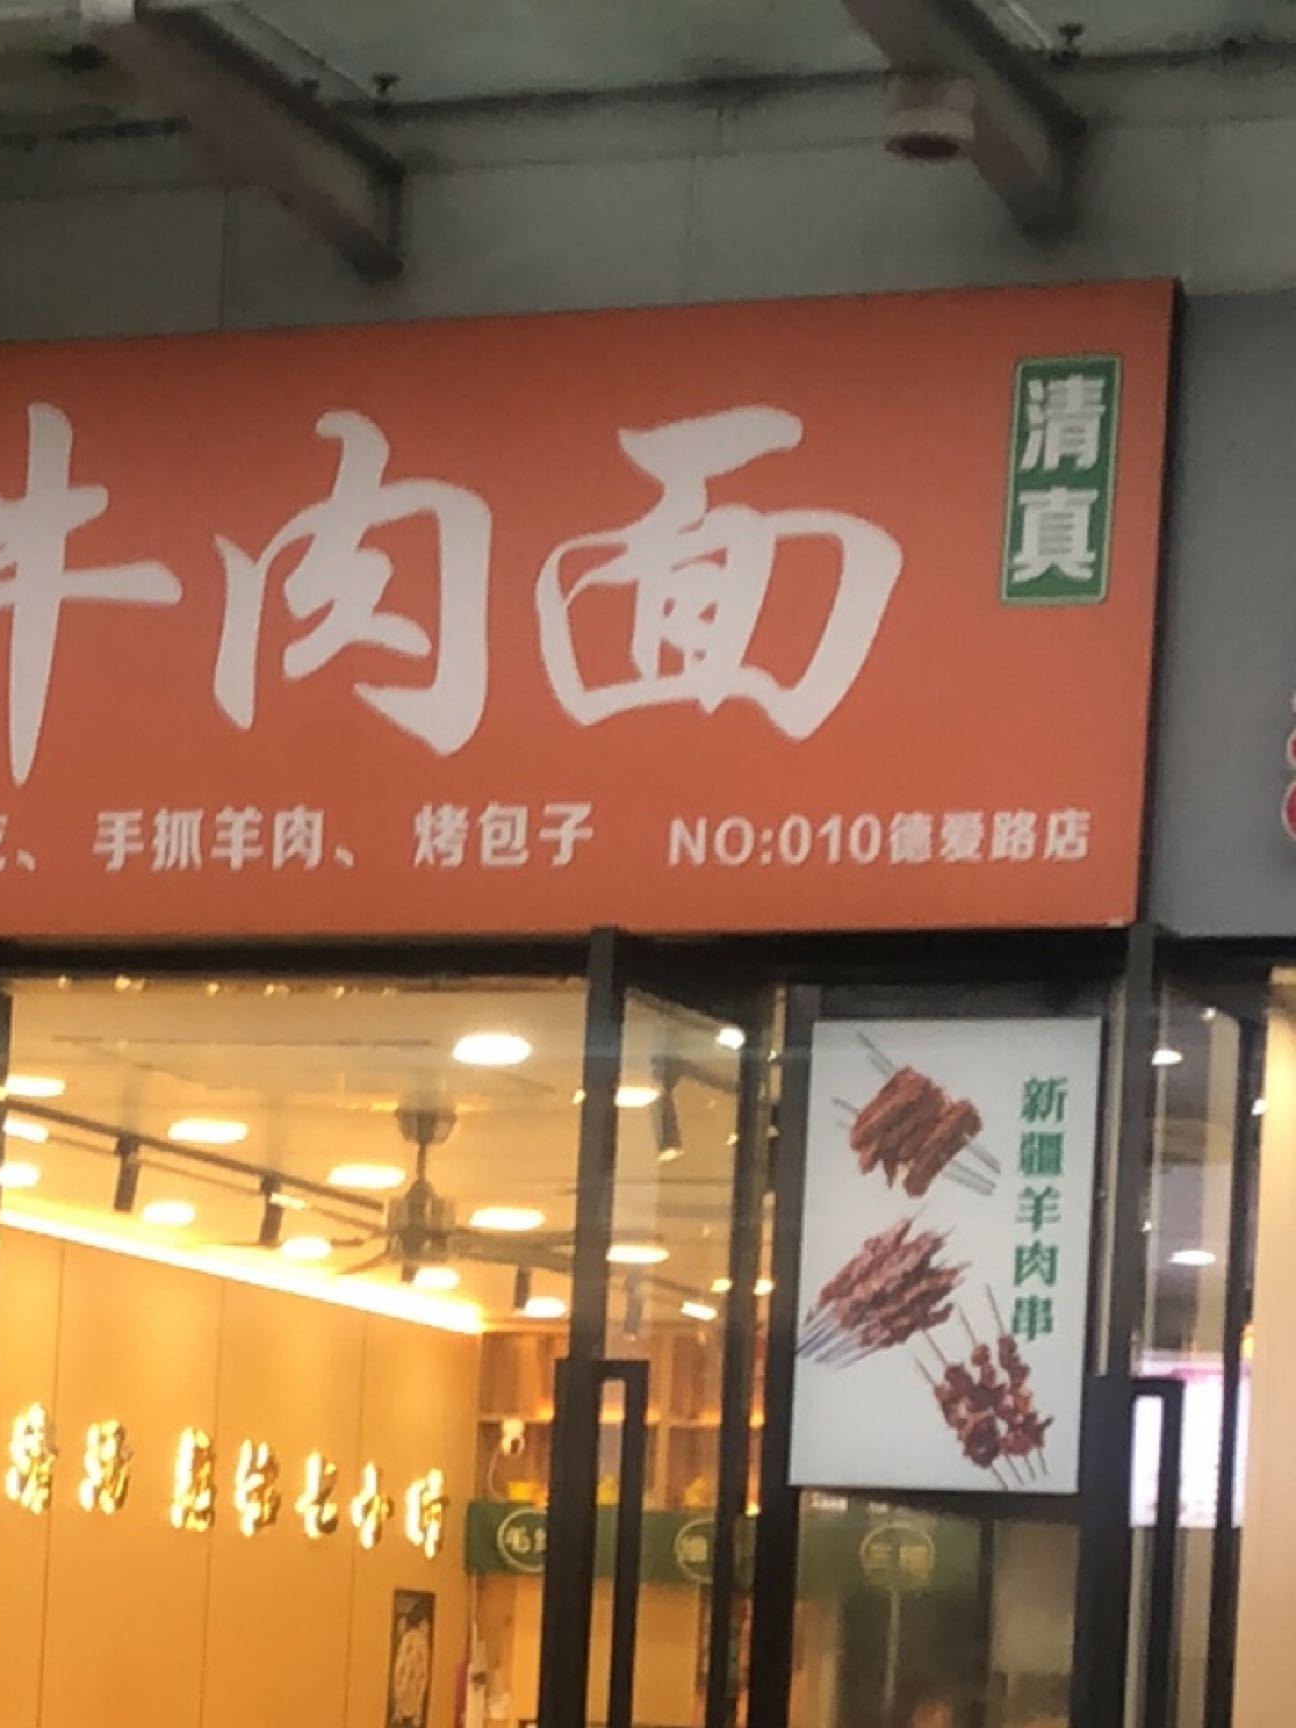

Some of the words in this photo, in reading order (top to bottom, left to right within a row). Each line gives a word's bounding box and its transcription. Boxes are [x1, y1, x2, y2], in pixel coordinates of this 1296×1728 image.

[1010, 374, 1107, 584] 清真
[1010, 1075, 1070, 1343] 新疆羊肉串
